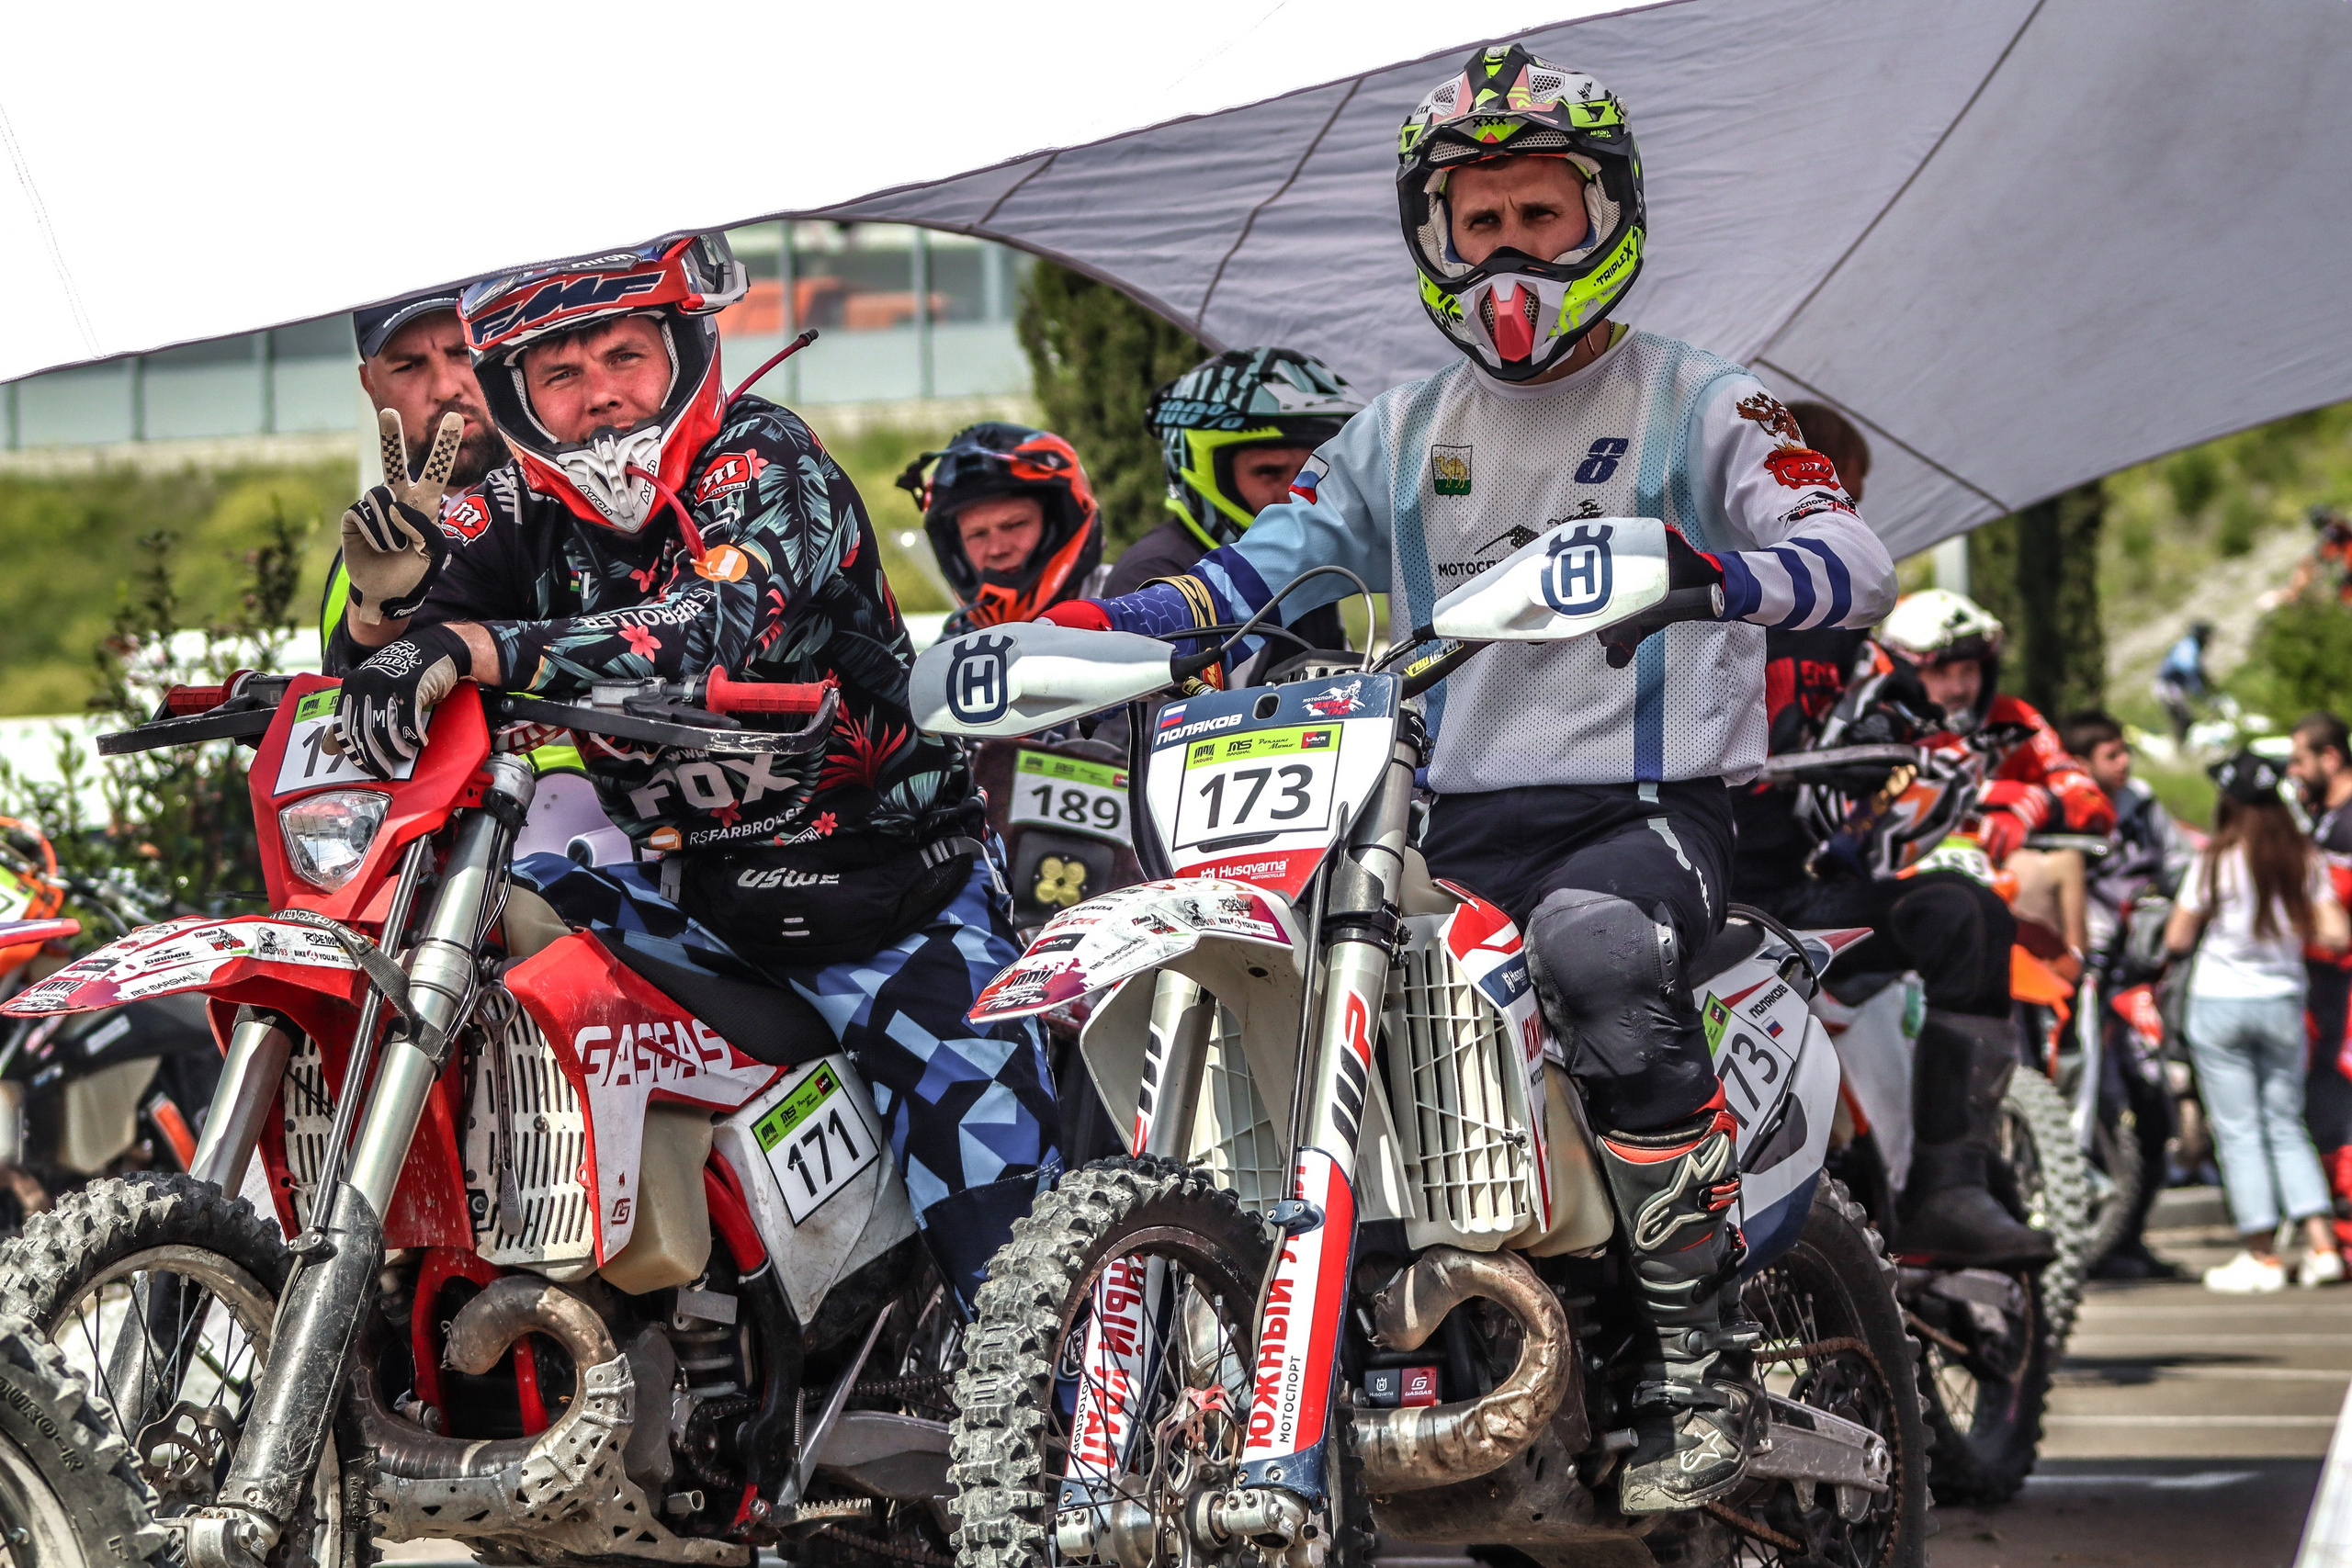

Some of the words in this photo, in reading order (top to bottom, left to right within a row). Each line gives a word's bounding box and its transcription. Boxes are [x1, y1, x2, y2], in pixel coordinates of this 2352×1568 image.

[1472, 116, 1508, 129] XXX
[469, 270, 668, 346] FMF
[1154, 400, 1246, 430] 100%
[578, 484, 613, 517] Airoh
[707, 483, 744, 499] ontesa
[1437, 558, 1507, 577] МОТОСП
[1302, 694, 1334, 704] МОТОСПОРТ
[1155, 713, 1243, 746] ПОЛЯКОВ
[1193, 756, 1214, 765] ENDURO
[625, 751, 800, 820] FOX
[1198, 763, 1313, 830] 173
[1030, 784, 1122, 830] 189
[1218, 859, 1287, 878] Husqvarna
[1748, 983, 1790, 1019] ПОЛЯКОВ
[574, 1018, 733, 1088] GASGAS
[786, 1107, 861, 1199] 171
[1278, 1355, 1302, 1443] МОТОСПОРТ
